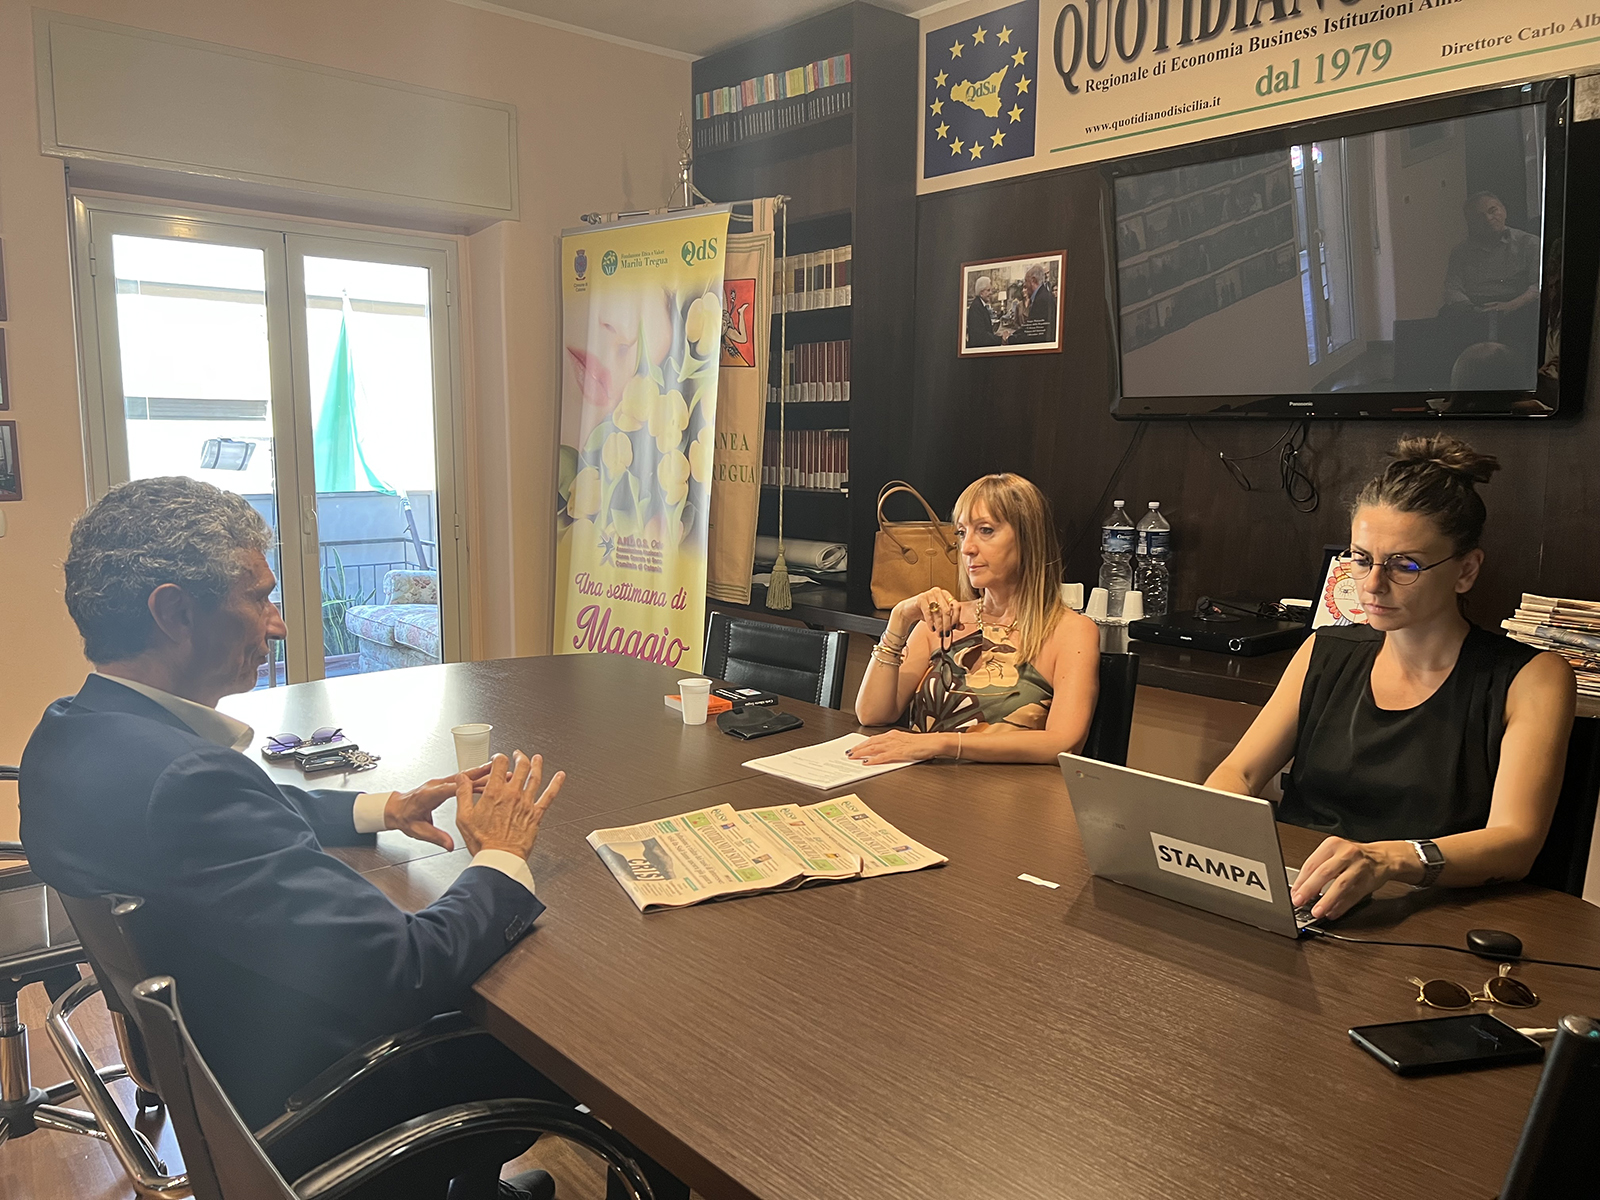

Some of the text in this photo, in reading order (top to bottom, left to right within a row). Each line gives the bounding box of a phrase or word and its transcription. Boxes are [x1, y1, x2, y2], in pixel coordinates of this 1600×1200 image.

[1085, 66, 1149, 93] Regionale
[1153, 59, 1166, 77] di
[1170, 44, 1243, 72] Economia
[1249, 24, 1317, 52] Business
[1323, 0, 1413, 35] Istituzioni
[1440, 13, 1600, 57] Direttore Carlo Alb
[1255, 38, 1392, 97] dal 1979
[1085, 96, 1221, 134] www.quotidianodisicilia.it
[621, 256, 668, 269] Marilù Tregua
[681, 238, 718, 266] QdS
[715, 432, 750, 451] NEA
[574, 572, 687, 610] Una settimana di
[628, 858, 665, 882] CRISI
[1158, 844, 1266, 892] STAMPA
